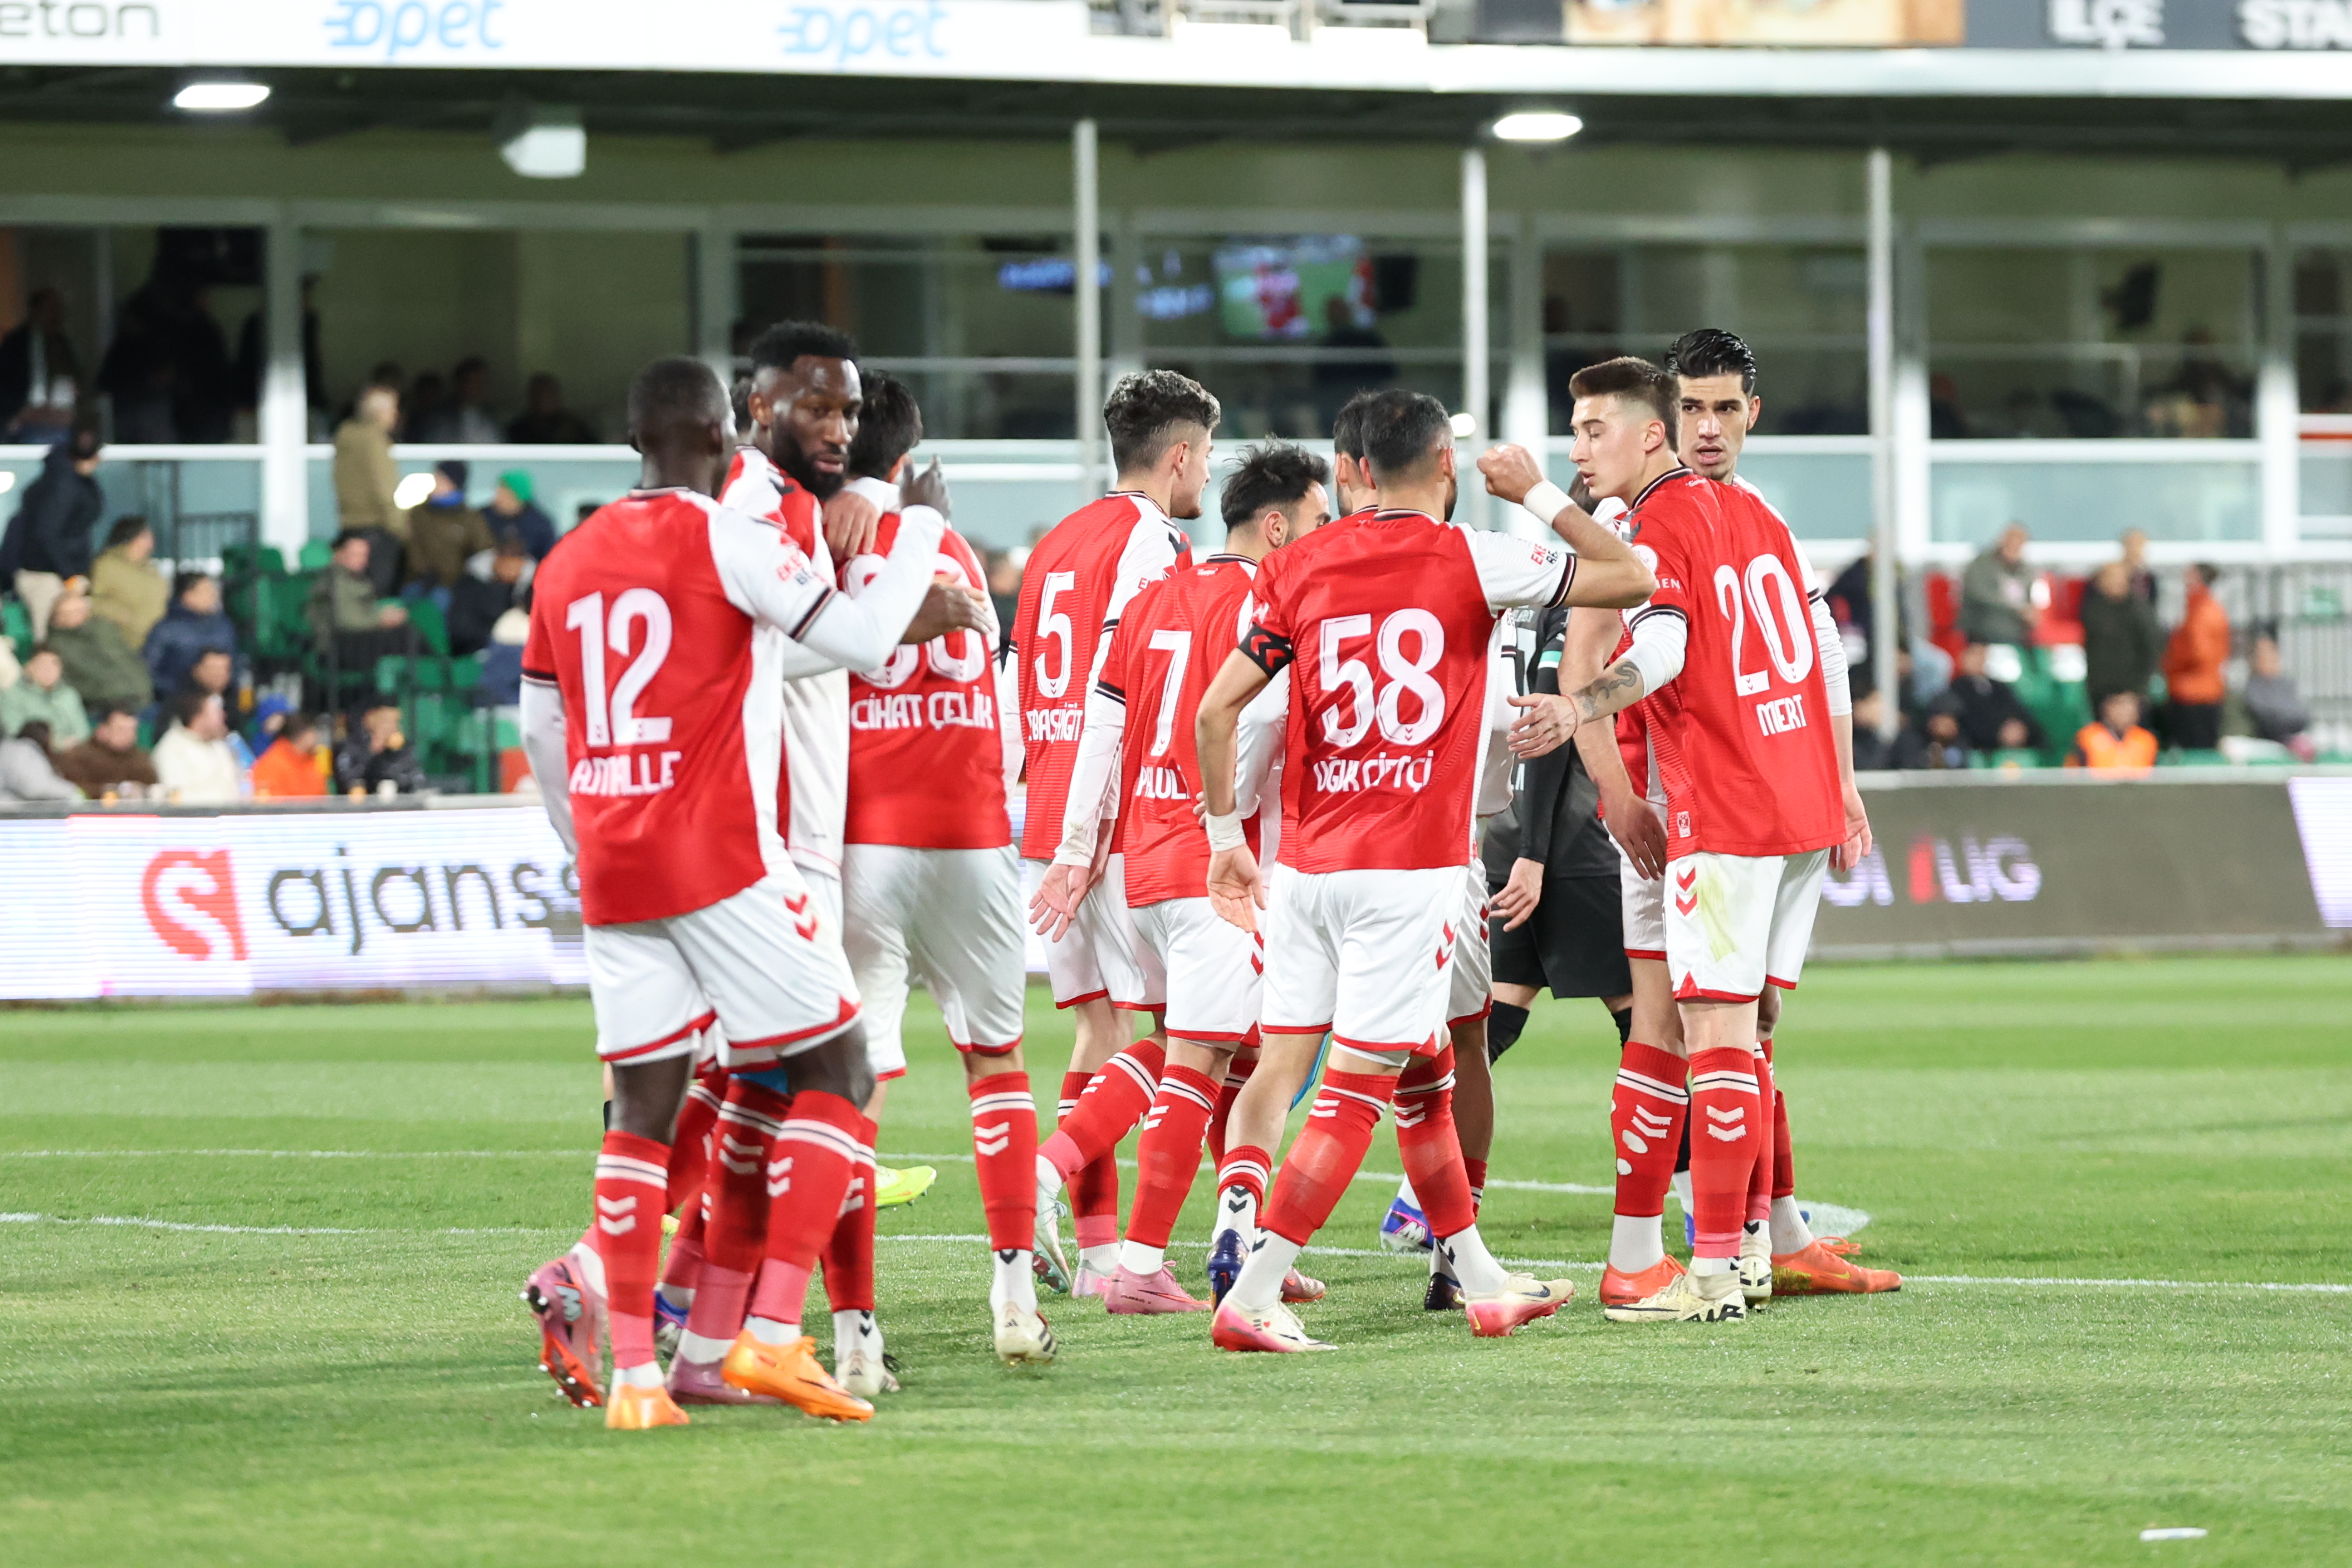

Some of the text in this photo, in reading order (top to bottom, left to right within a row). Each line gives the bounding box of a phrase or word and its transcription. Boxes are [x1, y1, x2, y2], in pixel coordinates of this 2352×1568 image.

[565, 587, 673, 748] 12
[1034, 570, 1076, 699] 5
[1319, 607, 1446, 748] 58
[1713, 553, 1814, 696] 20
[851, 685, 995, 731] CİHAT ÇELİK
[1148, 629, 1192, 756] 7
[1755, 694, 1807, 737] MERT
